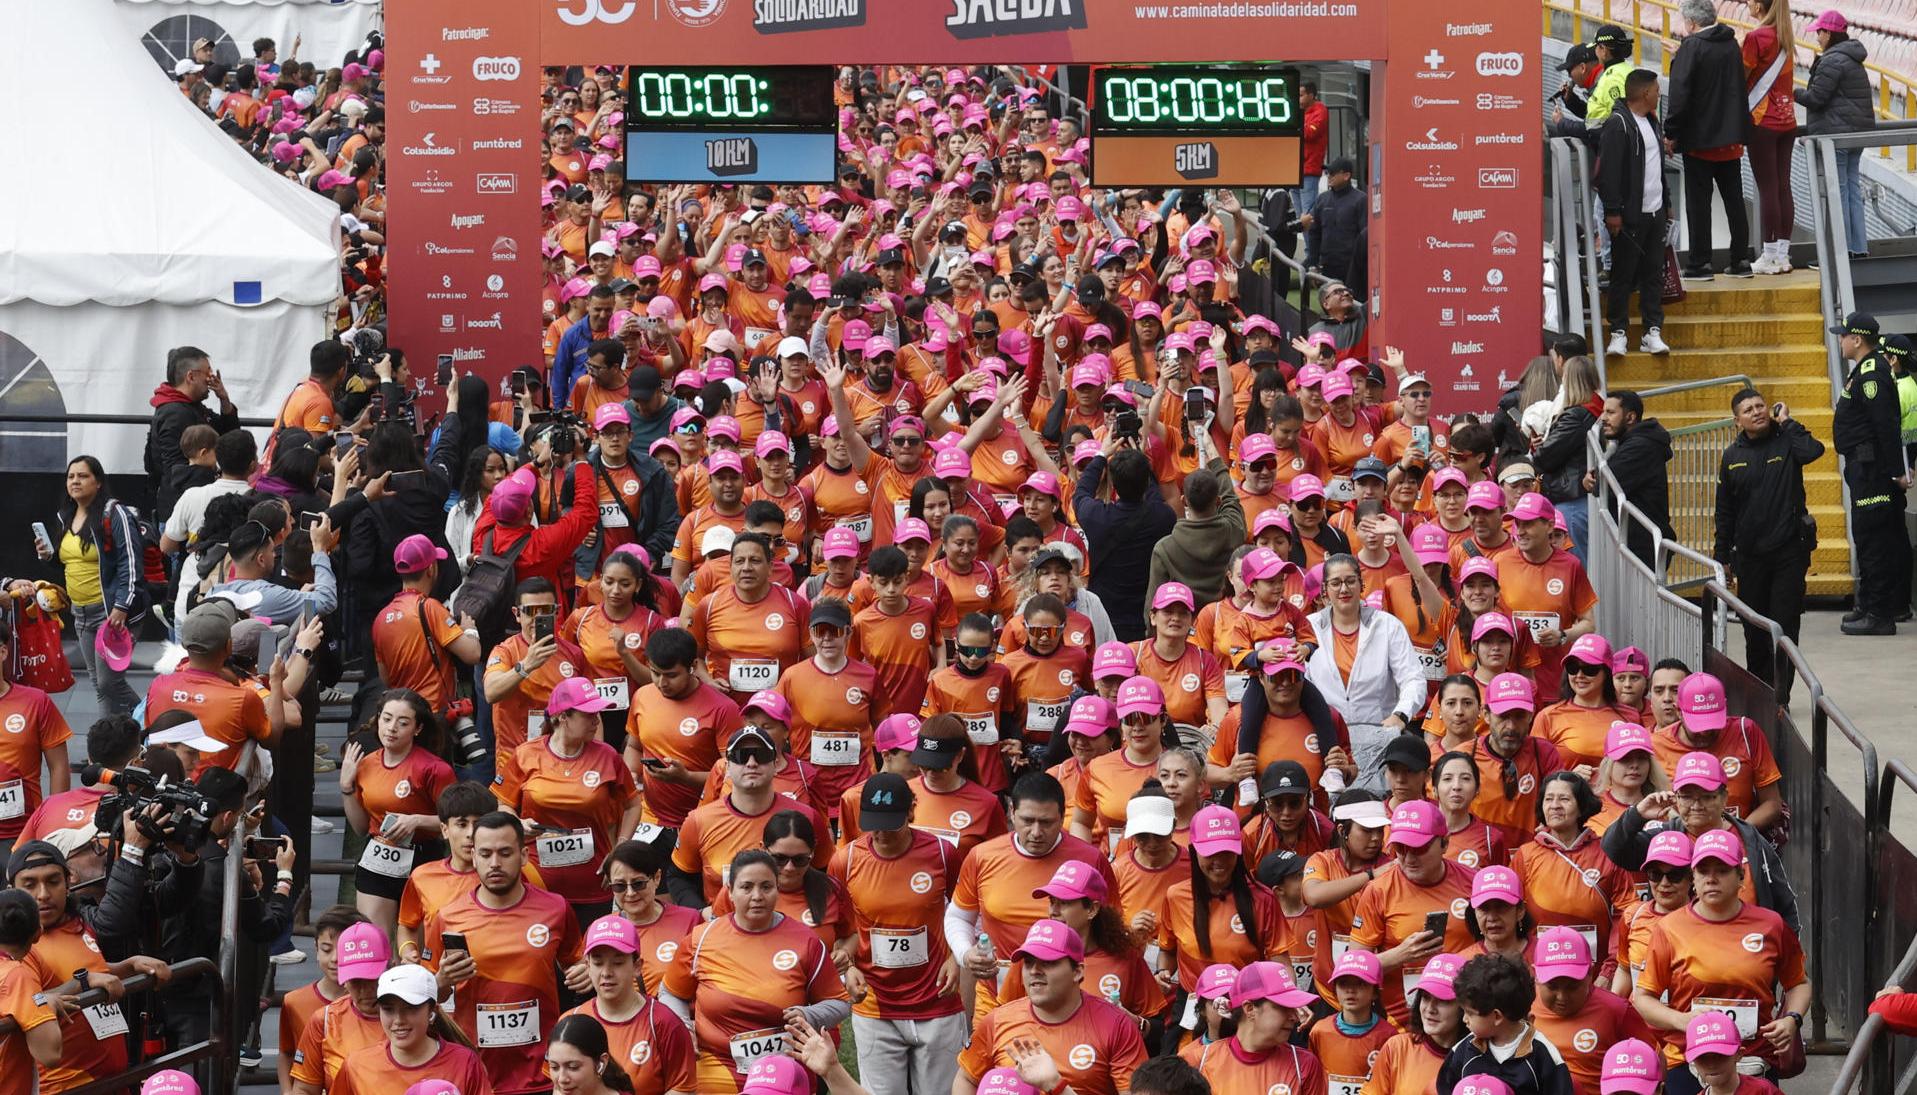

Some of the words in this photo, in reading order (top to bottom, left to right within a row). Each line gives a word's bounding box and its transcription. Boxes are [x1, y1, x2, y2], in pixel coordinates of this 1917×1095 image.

[1135, 2, 1357, 19] www.caminatadelasolidaridad.com
[442, 26, 489, 41] Patrocinan:
[1446, 23, 1492, 37] Patrocinan:
[477, 62, 516, 75] FRUCO
[1480, 59, 1519, 71] FRUCO
[403, 147, 456, 155] Colsubsidio
[1406, 142, 1458, 150] Colsubsidio
[705, 138, 750, 168] 10KM
[1175, 142, 1212, 173] 5KM
[451, 214, 485, 229] Apoyan:
[1452, 208, 1486, 224] Apoyan:
[482, 291, 509, 299] Acinpro
[1482, 285, 1508, 293] Acinpro
[1452, 341, 1484, 355] Aliados:
[452, 347, 485, 362] Aliados:
[23, 654, 46, 666] TOTTO
[739, 667, 770, 678] 1120
[1038, 706, 1062, 717] 288
[966, 721, 987, 732] 89
[823, 740, 849, 752] 481
[870, 790, 893, 805] 44
[1208, 818, 1220, 829] 50
[546, 838, 584, 853] 1021
[373, 845, 401, 862] 930
[344, 941, 356, 952] 50
[888, 938, 910, 952] 78
[1548, 942, 1560, 952] 50
[488, 1011, 529, 1029] 1137
[1696, 1024, 1708, 1034] 50
[741, 1037, 784, 1057] 1047
[1616, 1054, 1630, 1064] 50
[151, 1075, 165, 1086] 50
[990, 1074, 1004, 1084] 50
